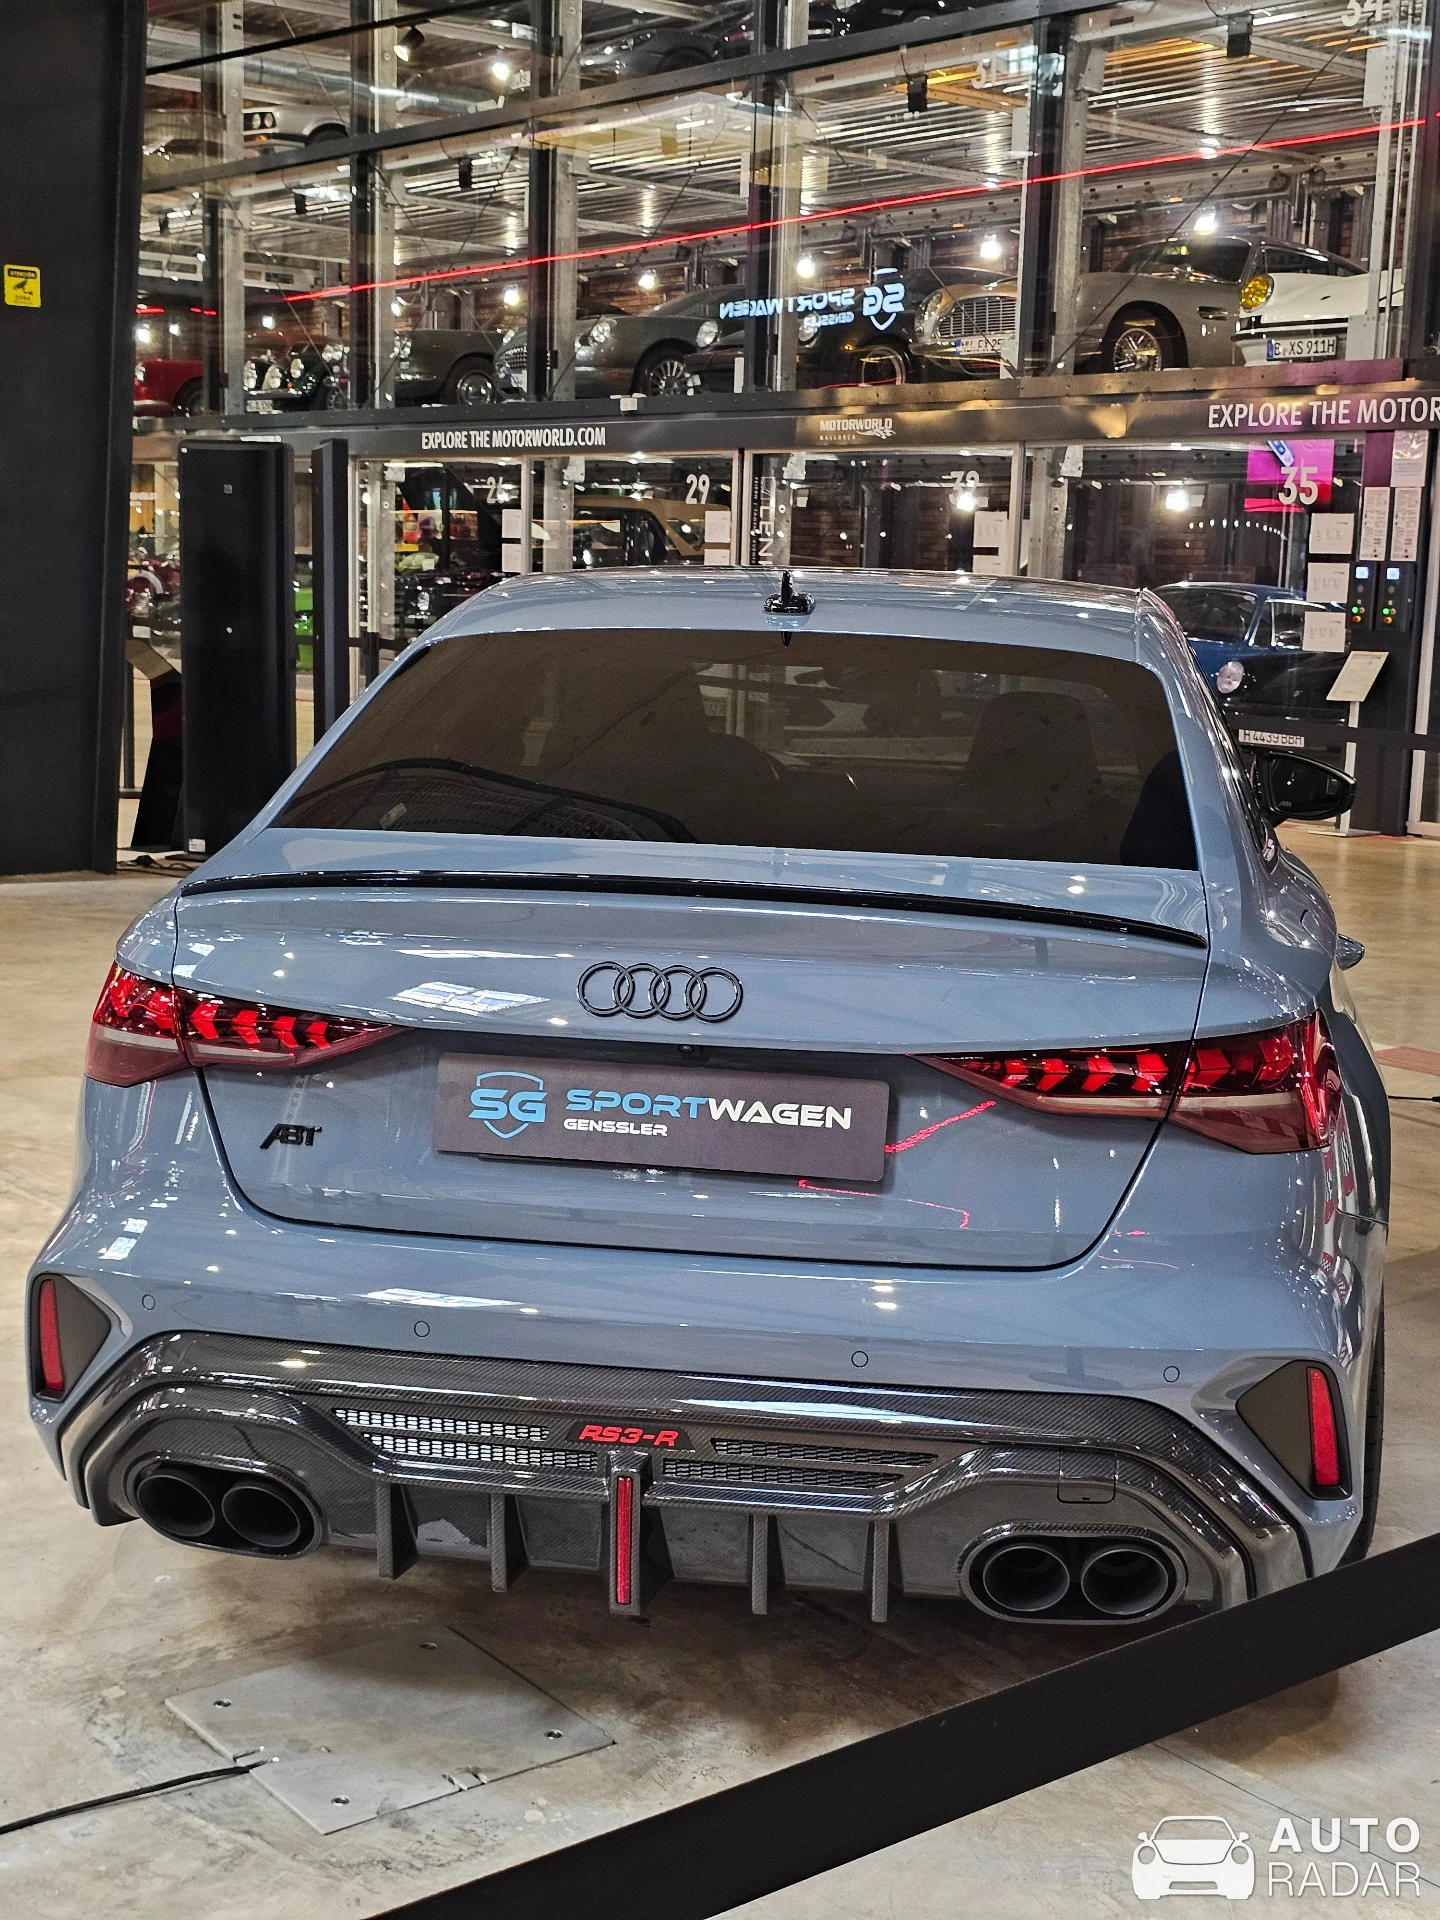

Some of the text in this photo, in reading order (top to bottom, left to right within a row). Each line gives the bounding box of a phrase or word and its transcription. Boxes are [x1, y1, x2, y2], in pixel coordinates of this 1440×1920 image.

[1341, 0, 1382, 26] 34
[820, 417, 893, 431] MOTORWORLD
[1208, 402, 1303, 428] EXPLORE
[1308, 400, 1350, 425] THE
[421, 426, 606, 449] EXPLORE THE MOTORWORLD.COM
[685, 474, 710, 505] 29
[1278, 466, 1319, 505] 35
[469, 1088, 852, 1130] SG SPORTWAGEN
[259, 1123, 322, 1150] ABT
[563, 1118, 668, 1137] GENSSLER
[579, 1424, 679, 1447] RS3-R
